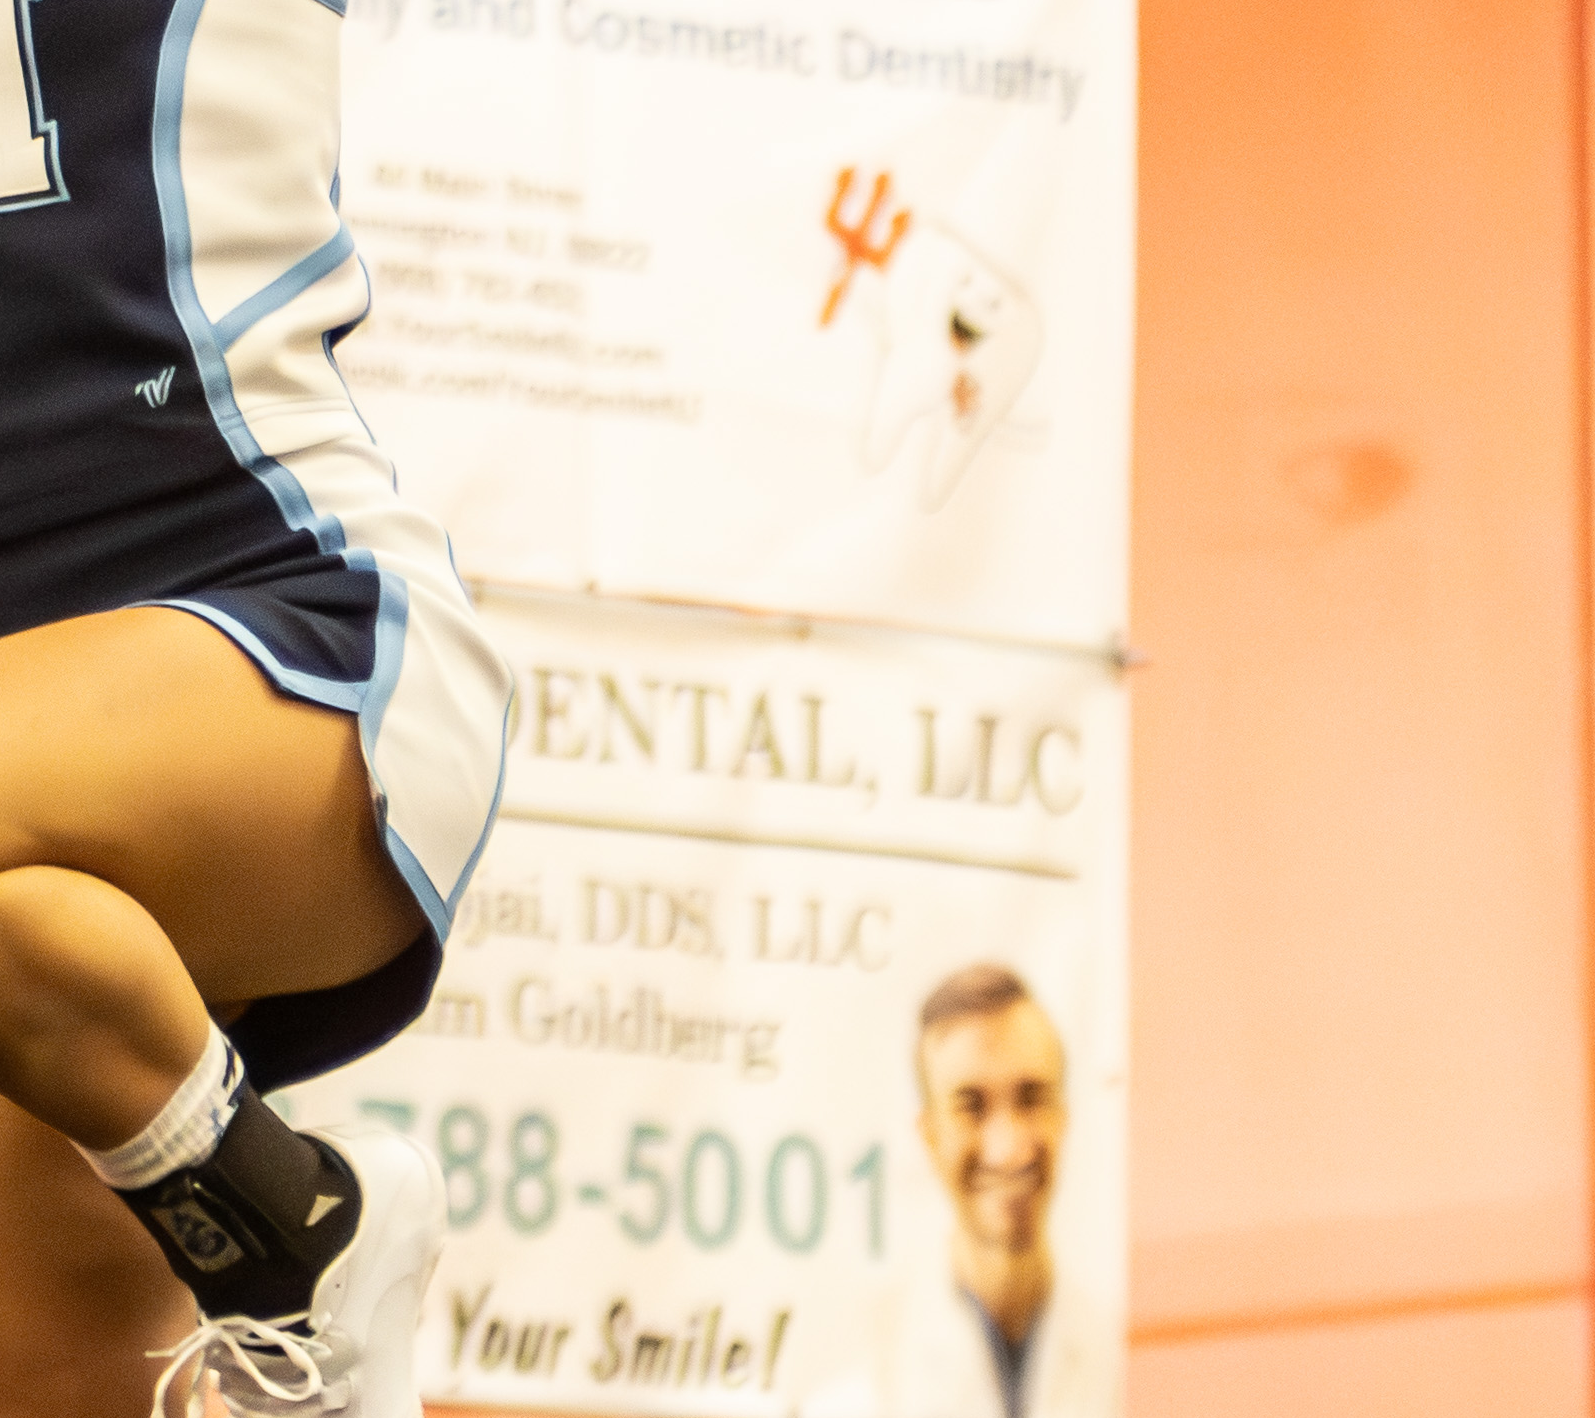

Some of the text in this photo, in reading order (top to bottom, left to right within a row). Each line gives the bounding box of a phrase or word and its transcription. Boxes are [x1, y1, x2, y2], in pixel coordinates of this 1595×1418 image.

[911, 705, 1087, 819] LLC
[750, 893, 897, 973] LLC
[507, 985, 783, 1081] Goldberg
[445, 1281, 795, 1391] Your Smile!
